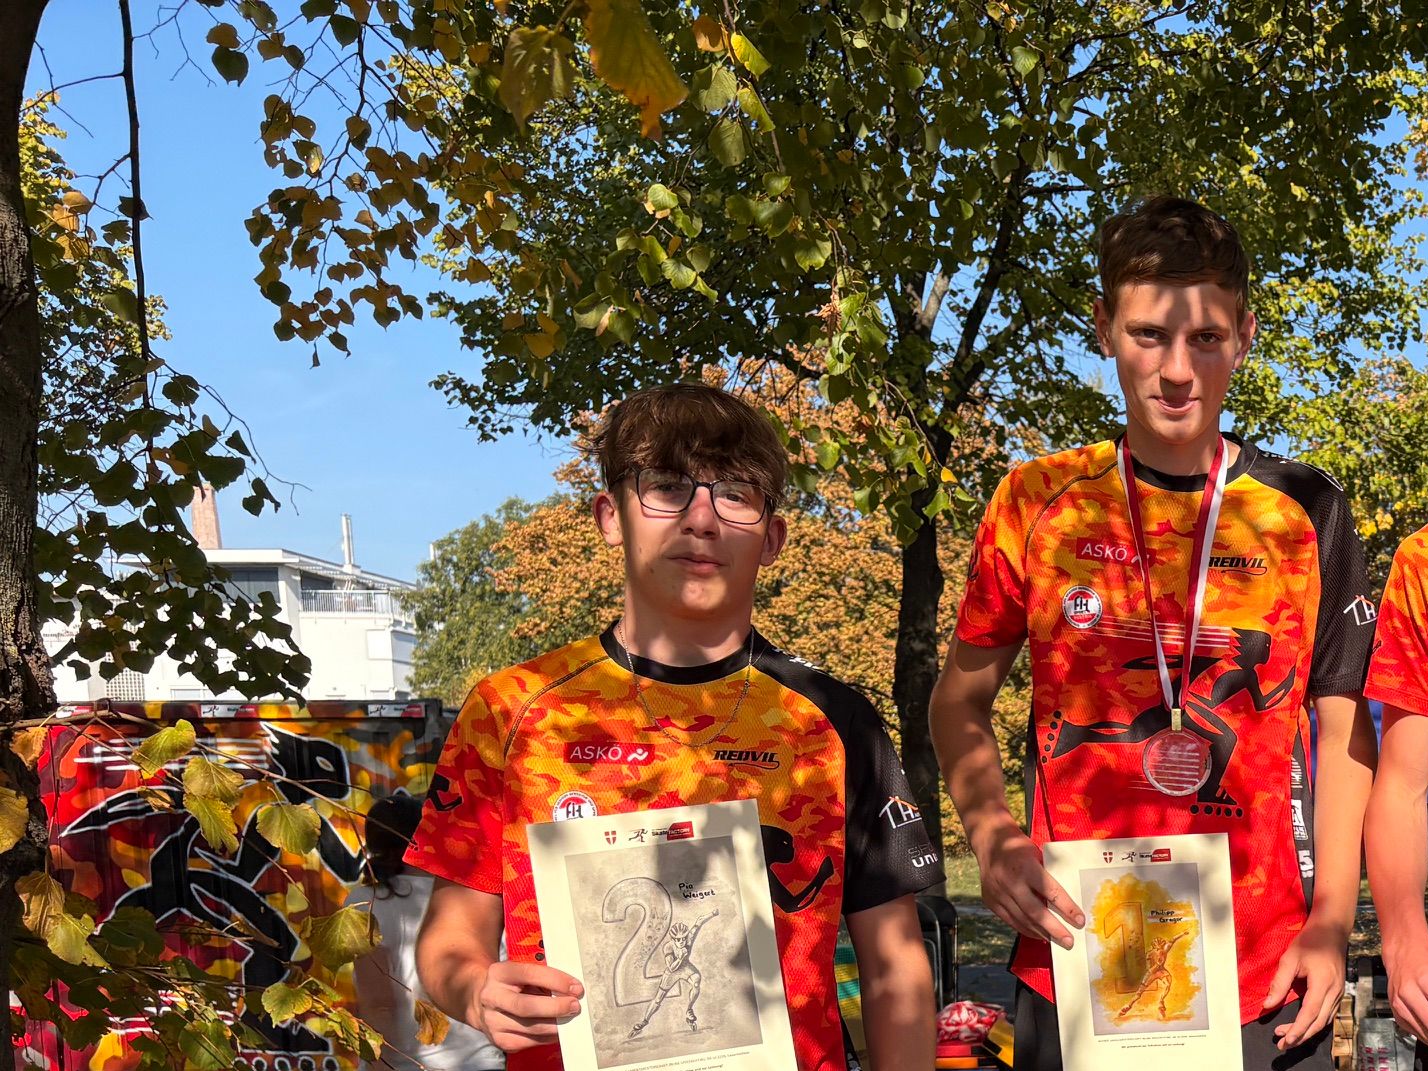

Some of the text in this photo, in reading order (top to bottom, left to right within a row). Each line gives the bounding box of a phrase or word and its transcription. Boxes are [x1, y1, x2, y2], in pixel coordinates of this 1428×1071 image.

[1081, 543, 1128, 561] ASKÖ
[570, 744, 622, 761] ASKÖ
[713, 749, 779, 763] REDVIL
